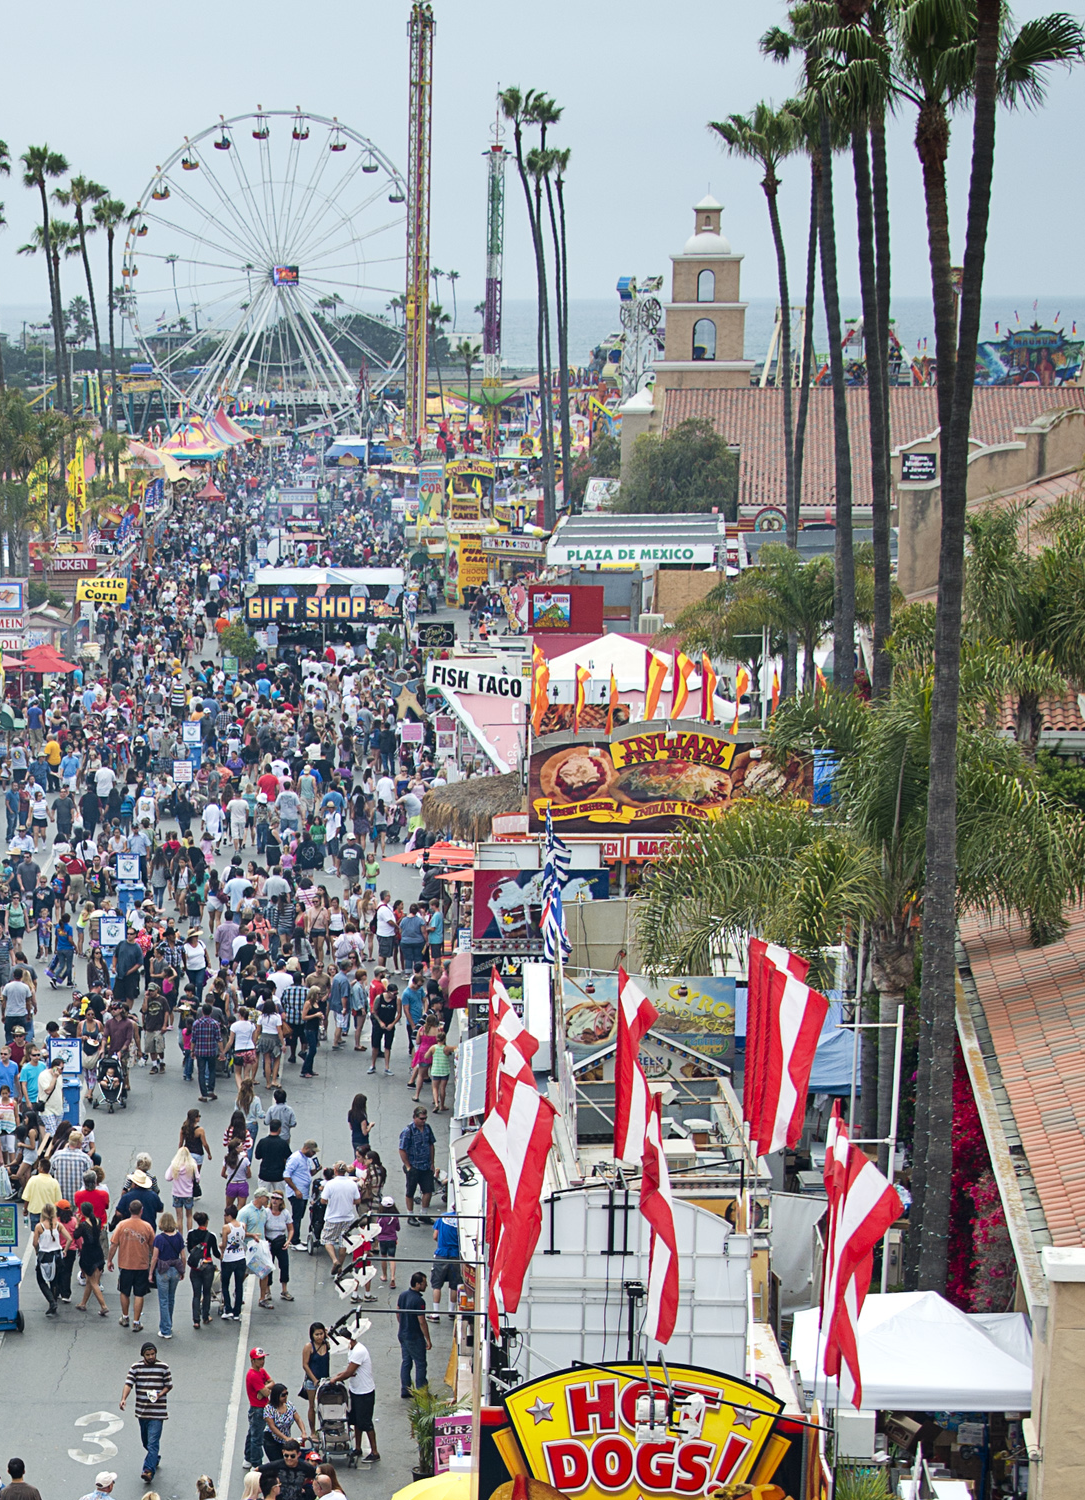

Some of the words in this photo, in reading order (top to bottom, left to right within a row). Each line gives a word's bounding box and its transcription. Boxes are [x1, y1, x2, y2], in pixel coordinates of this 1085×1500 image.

[446, 466, 468, 475] CORN
[471, 465, 493, 475] DOGS
[567, 548, 614, 561] PLAZA
[618, 548, 635, 560] DE
[640, 548, 694, 561] MEXICO
[81, 579, 124, 590] Kettle
[84, 589, 117, 601] Corn
[249, 597, 298, 619] GIFT
[306, 596, 366, 618] SHOP
[432, 665, 470, 690] FISH
[477, 673, 522, 698] TACO
[620, 751, 658, 765] FRY
[668, 749, 727, 767] BREAD
[634, 802, 677, 818] INDIAN
[565, 1379, 723, 1437] HOT
[68, 1411, 124, 1465] 3
[542, 1432, 752, 1498] DOGS!
